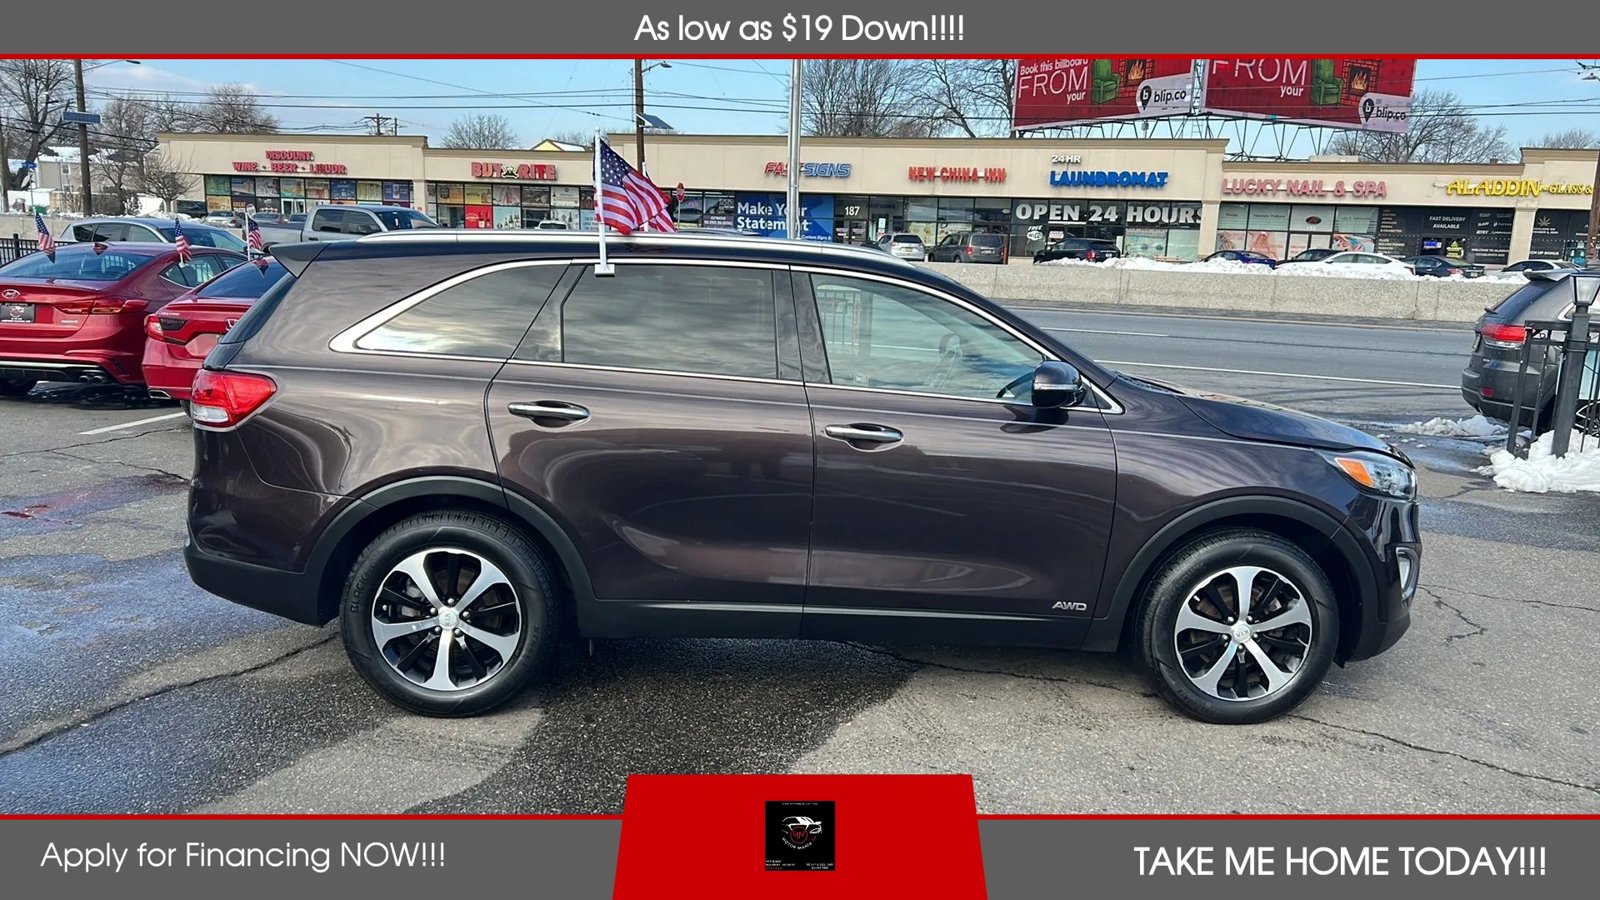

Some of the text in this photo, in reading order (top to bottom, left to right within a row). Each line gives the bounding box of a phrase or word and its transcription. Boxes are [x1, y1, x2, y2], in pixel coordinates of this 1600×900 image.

[1020, 65, 1038, 76] Book
[1040, 61, 1053, 71] this
[1211, 58, 1308, 86] FROM
[1018, 67, 1088, 98] FROM
[1067, 91, 1085, 104] your
[1153, 88, 1187, 104] blip.co
[1280, 85, 1304, 98] your
[1376, 107, 1406, 121] blip.co
[265, 151, 314, 161] DISCOUNT
[232, 162, 347, 174] WINE BEER LIQUOR
[471, 162, 557, 180] BUY RITE
[908, 166, 1006, 184] NEW CHINA INN
[1049, 170, 1168, 187] LAUNDROMAT
[1222, 178, 1388, 197] LUCKY NAIL & SPA
[1447, 178, 1593, 197] ALADDIN GLASS &
[737, 202, 808, 217] Make Yr
[845, 206, 860, 216] 187
[1015, 203, 1079, 222] OPEN
[1088, 205, 1118, 222] 24
[736, 216, 812, 231] Statemt
[1052, 601, 1087, 611] AWD
